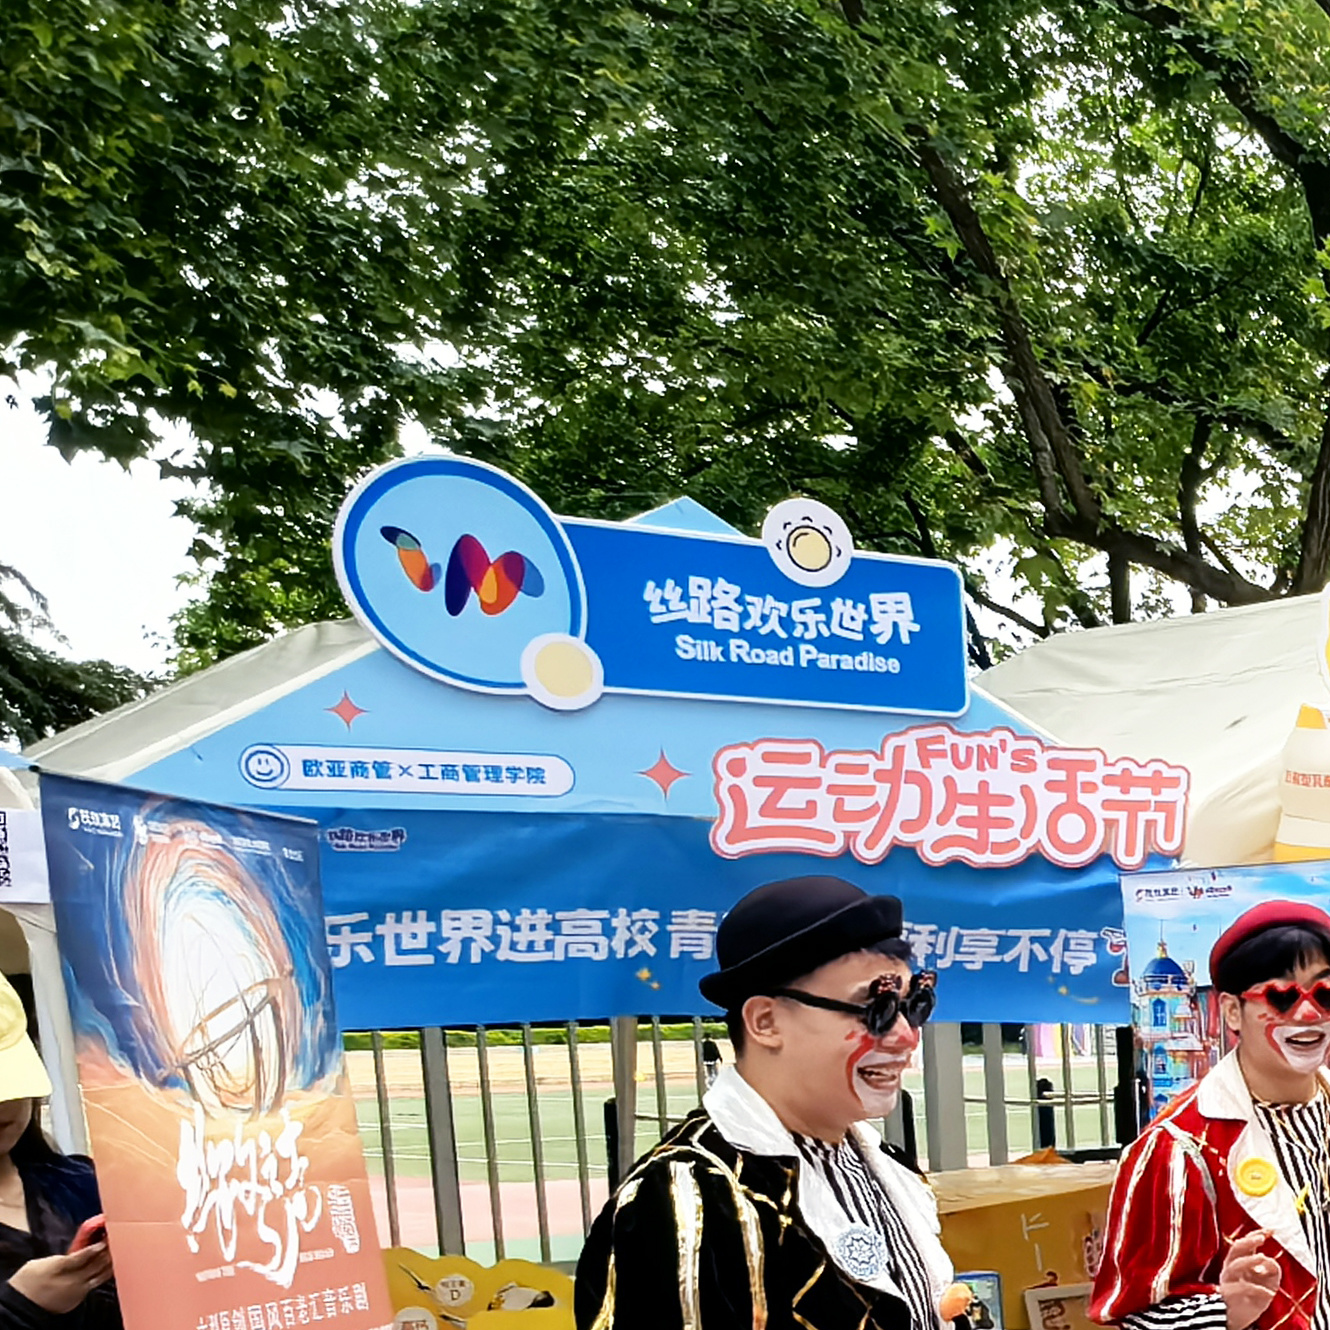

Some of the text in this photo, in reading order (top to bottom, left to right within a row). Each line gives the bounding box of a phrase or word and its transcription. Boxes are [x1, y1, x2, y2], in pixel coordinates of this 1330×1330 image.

[643, 575, 921, 645] 丝路欢乐世界
[675, 634, 901, 674] Silk Road Paradise
[722, 742, 1187, 860] 运动生活节
